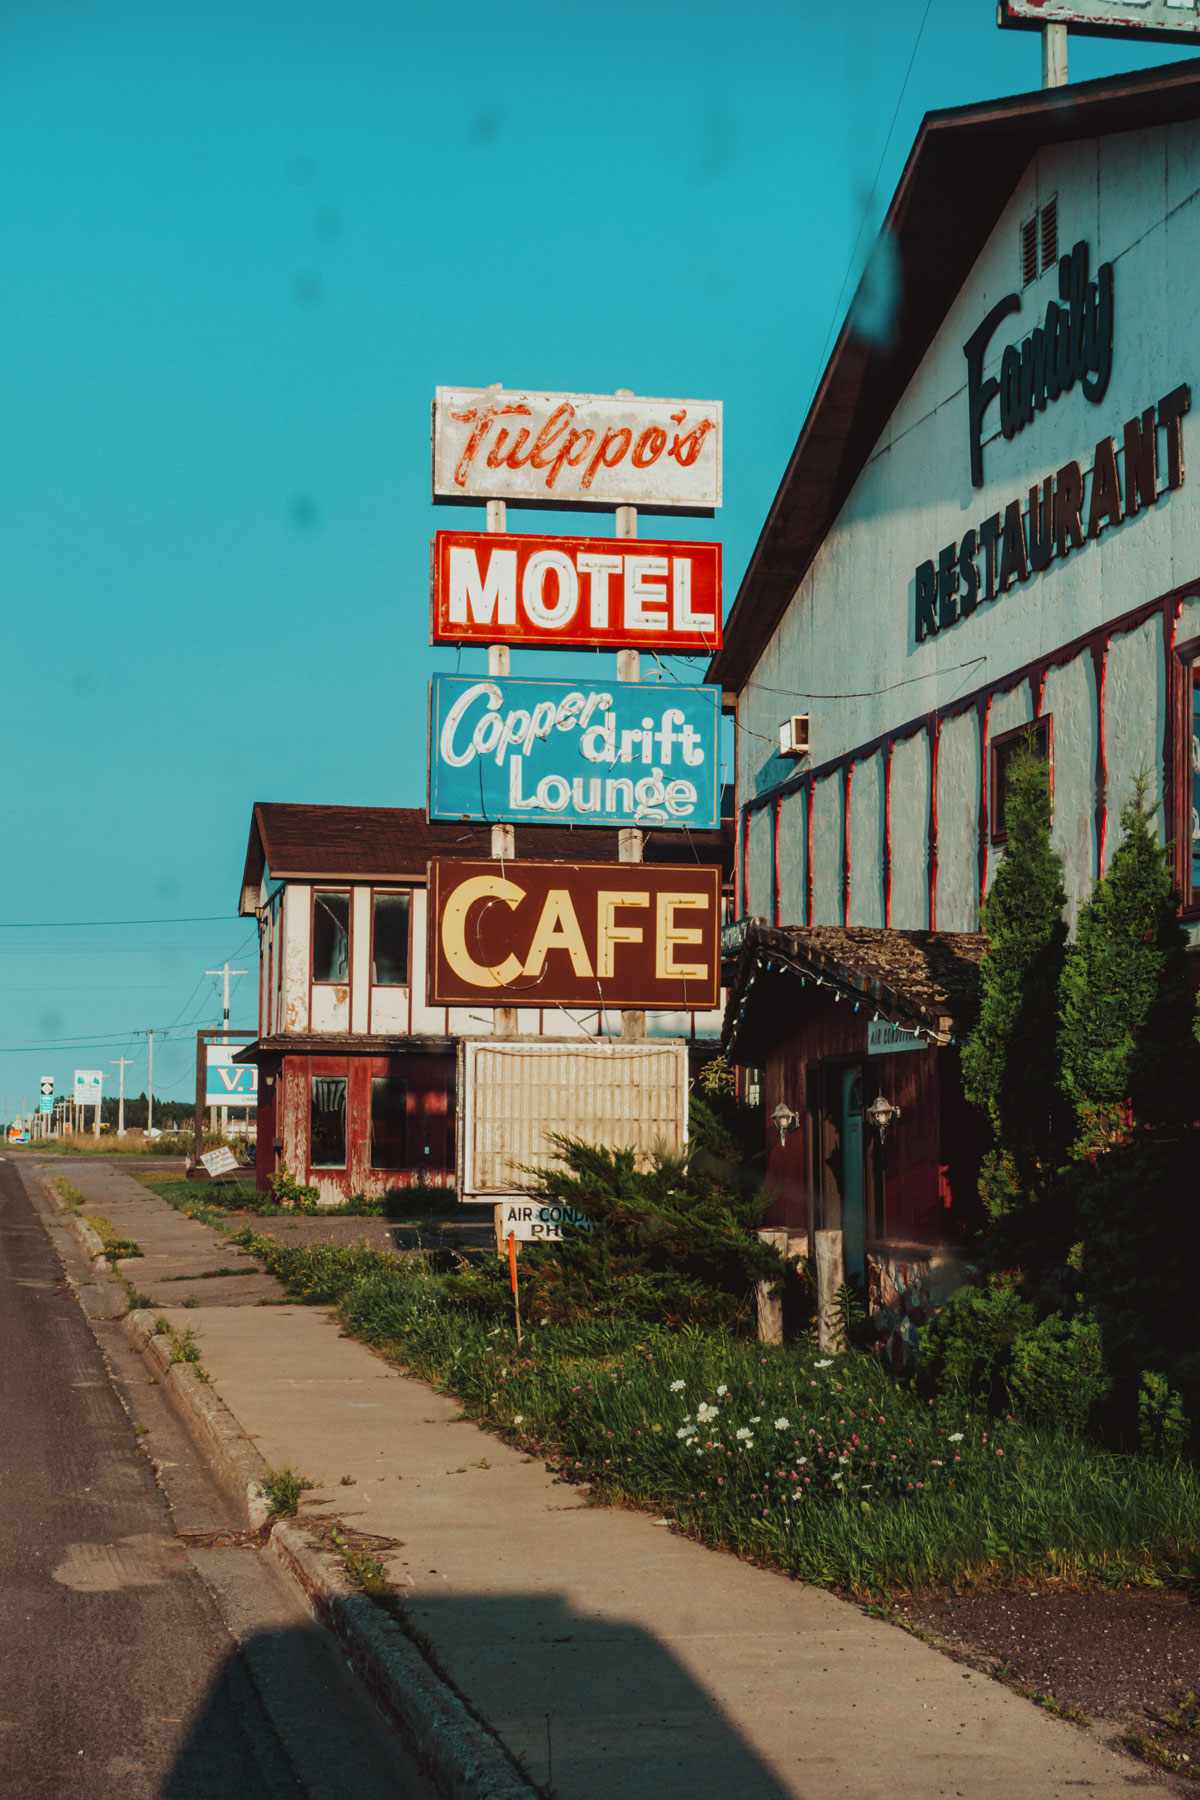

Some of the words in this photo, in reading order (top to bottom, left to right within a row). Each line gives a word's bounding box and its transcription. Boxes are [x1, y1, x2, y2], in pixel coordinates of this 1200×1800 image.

[962, 239, 1114, 488] Family
[449, 402, 715, 489] Tulppo's
[915, 382, 1191, 643] RESTAURANT
[449, 547, 715, 632] MOTEL
[440, 683, 613, 767] Copper
[580, 709, 705, 767] drift
[509, 767, 698, 824] Lounge
[441, 875, 709, 988] CAFE
[871, 1028, 881, 1046] AIR
[507, 1207, 532, 1222] AIR
